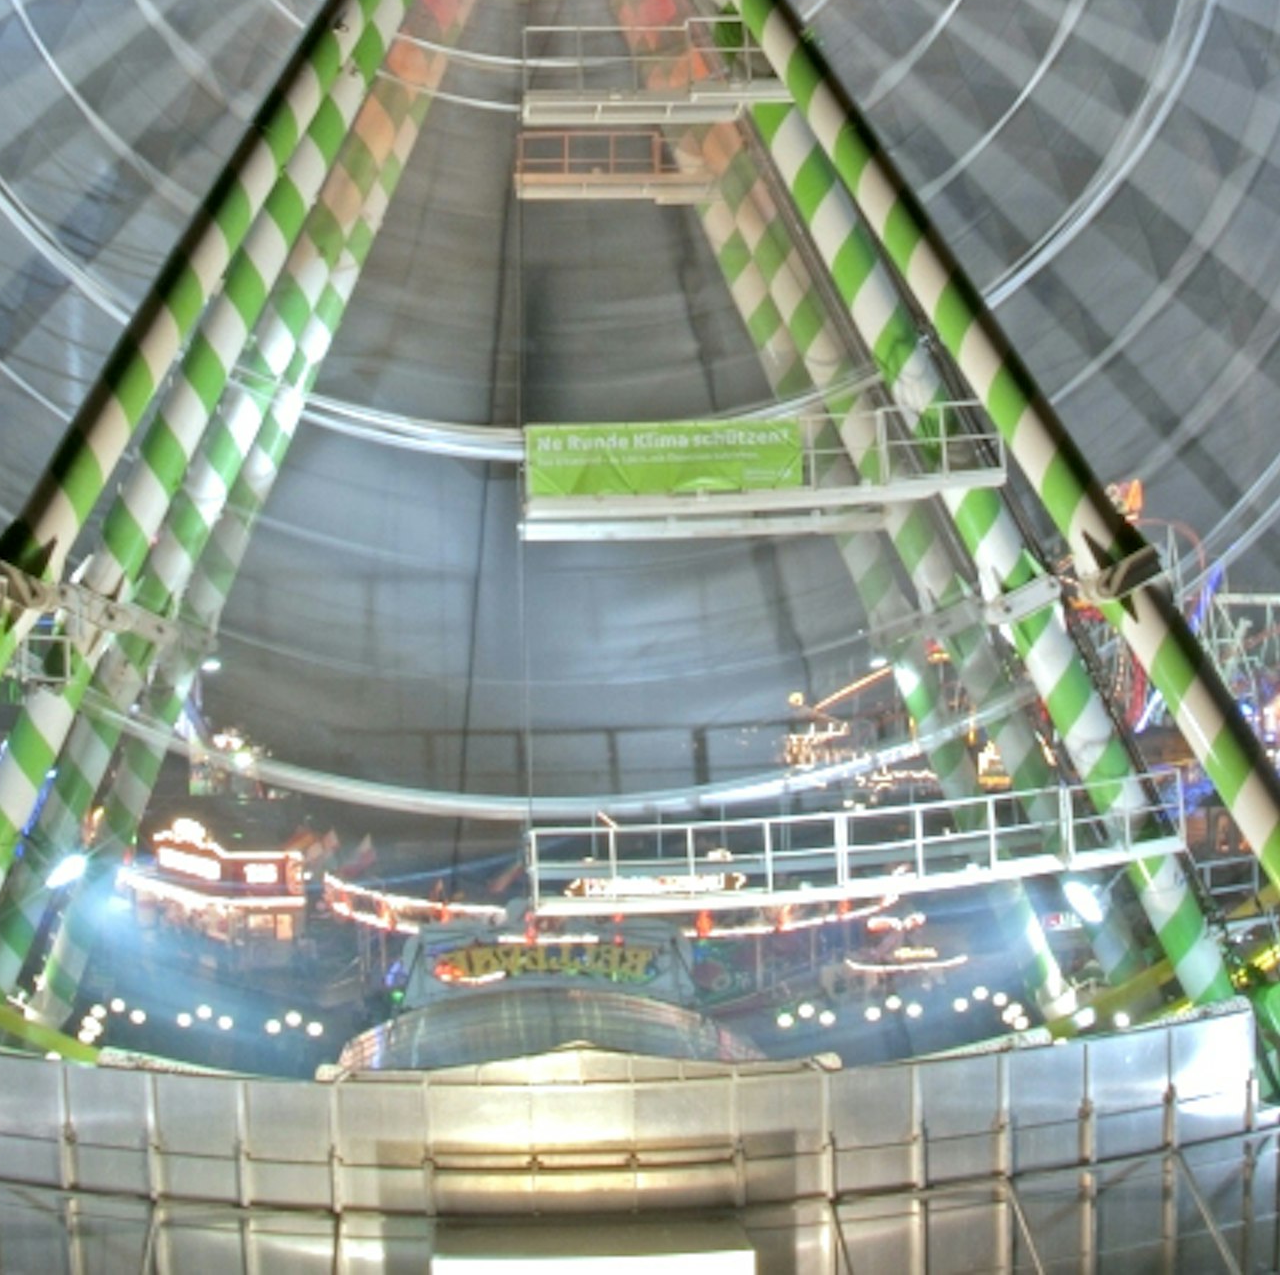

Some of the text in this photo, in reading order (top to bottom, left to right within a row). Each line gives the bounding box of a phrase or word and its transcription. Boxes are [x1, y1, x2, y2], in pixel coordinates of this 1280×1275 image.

[537, 436, 562, 451] Ne
[567, 433, 629, 450] Runde
[633, 431, 688, 449] Klima
